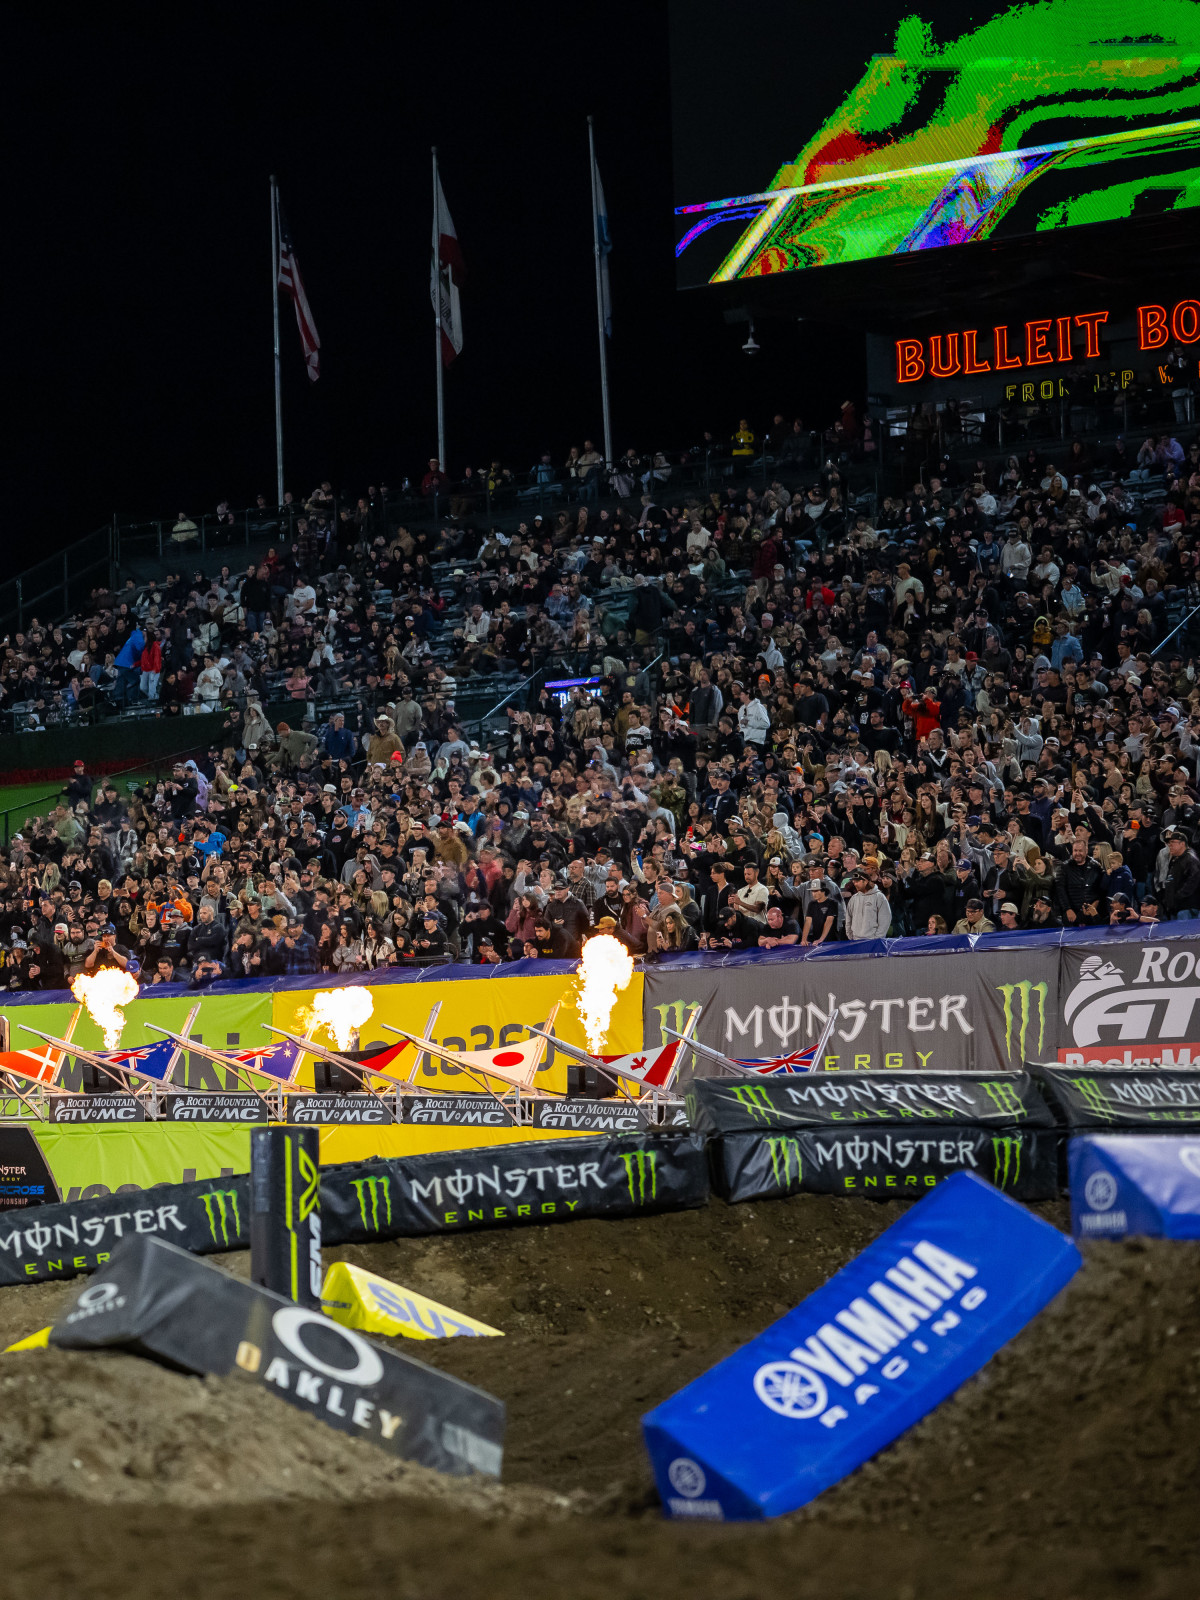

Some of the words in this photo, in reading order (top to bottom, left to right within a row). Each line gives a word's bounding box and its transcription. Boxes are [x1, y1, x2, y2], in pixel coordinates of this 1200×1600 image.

[895, 311, 1109, 383] BULLEIT
[724, 993, 974, 1049] MONSTER
[824, 1050, 934, 1072] ERGY
[66, 1098, 91, 1107] ROCKY
[91, 1097, 137, 1107] MOUNTAIN
[186, 1096, 212, 1107] ROCKY
[213, 1097, 260, 1107] MOUNTAIN
[306, 1098, 332, 1108] ROCKY
[334, 1099, 383, 1109] MOUNTAIN
[425, 1098, 453, 1109] ROCKY
[784, 1080, 976, 1107] MONSTER
[554, 1102, 585, 1114] ROCKY
[586, 1104, 639, 1117] MOUNTAIN
[815, 1135, 979, 1171] MONSTER
[408, 1162, 607, 1205] MONSTER
[844, 1175, 937, 1188] ENERG
[445, 1200, 580, 1224] ENERGY
[25, 1252, 111, 1275] ENER
[790, 1240, 978, 1387] YAMAHA
[820, 1286, 988, 1429] RACING
[236, 1341, 402, 1440] OAKLEY
